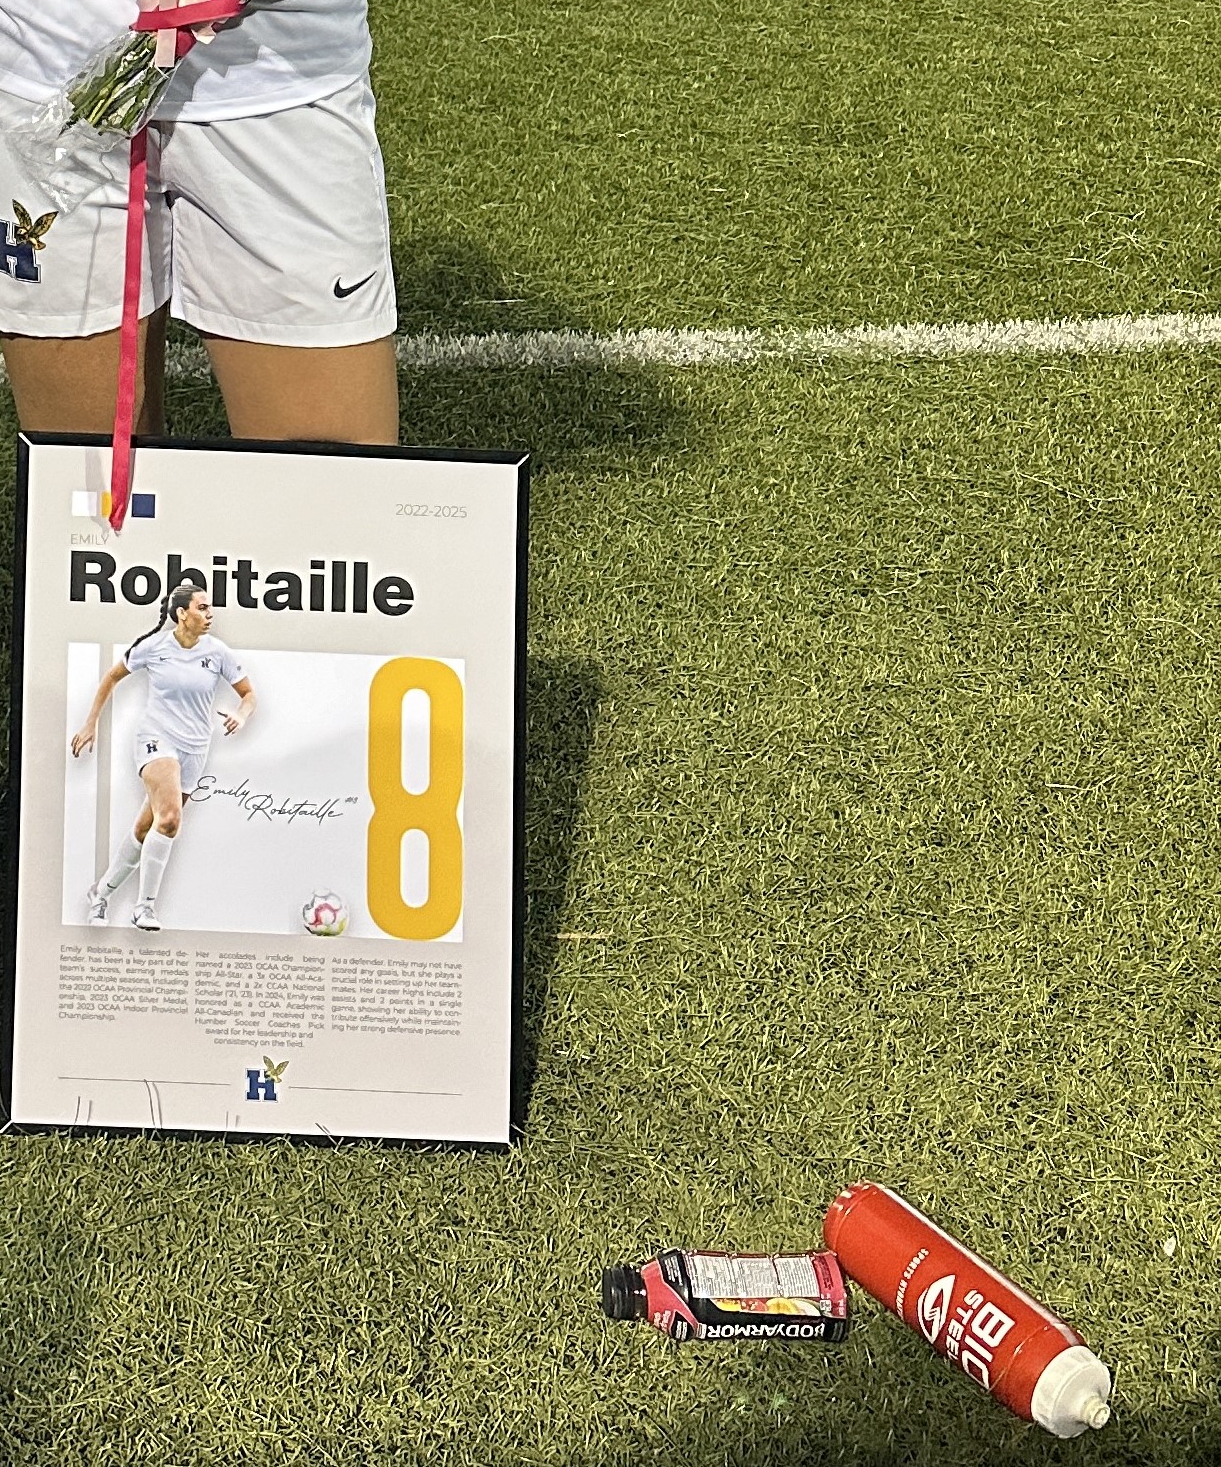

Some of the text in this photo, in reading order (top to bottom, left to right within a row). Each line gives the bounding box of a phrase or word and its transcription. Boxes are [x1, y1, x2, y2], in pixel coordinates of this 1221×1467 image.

[395, 503, 468, 519] 2022-2025
[70, 533, 109, 546] EMILY
[190, 775, 251, 807] Emily
[366, 656, 465, 942] 8
